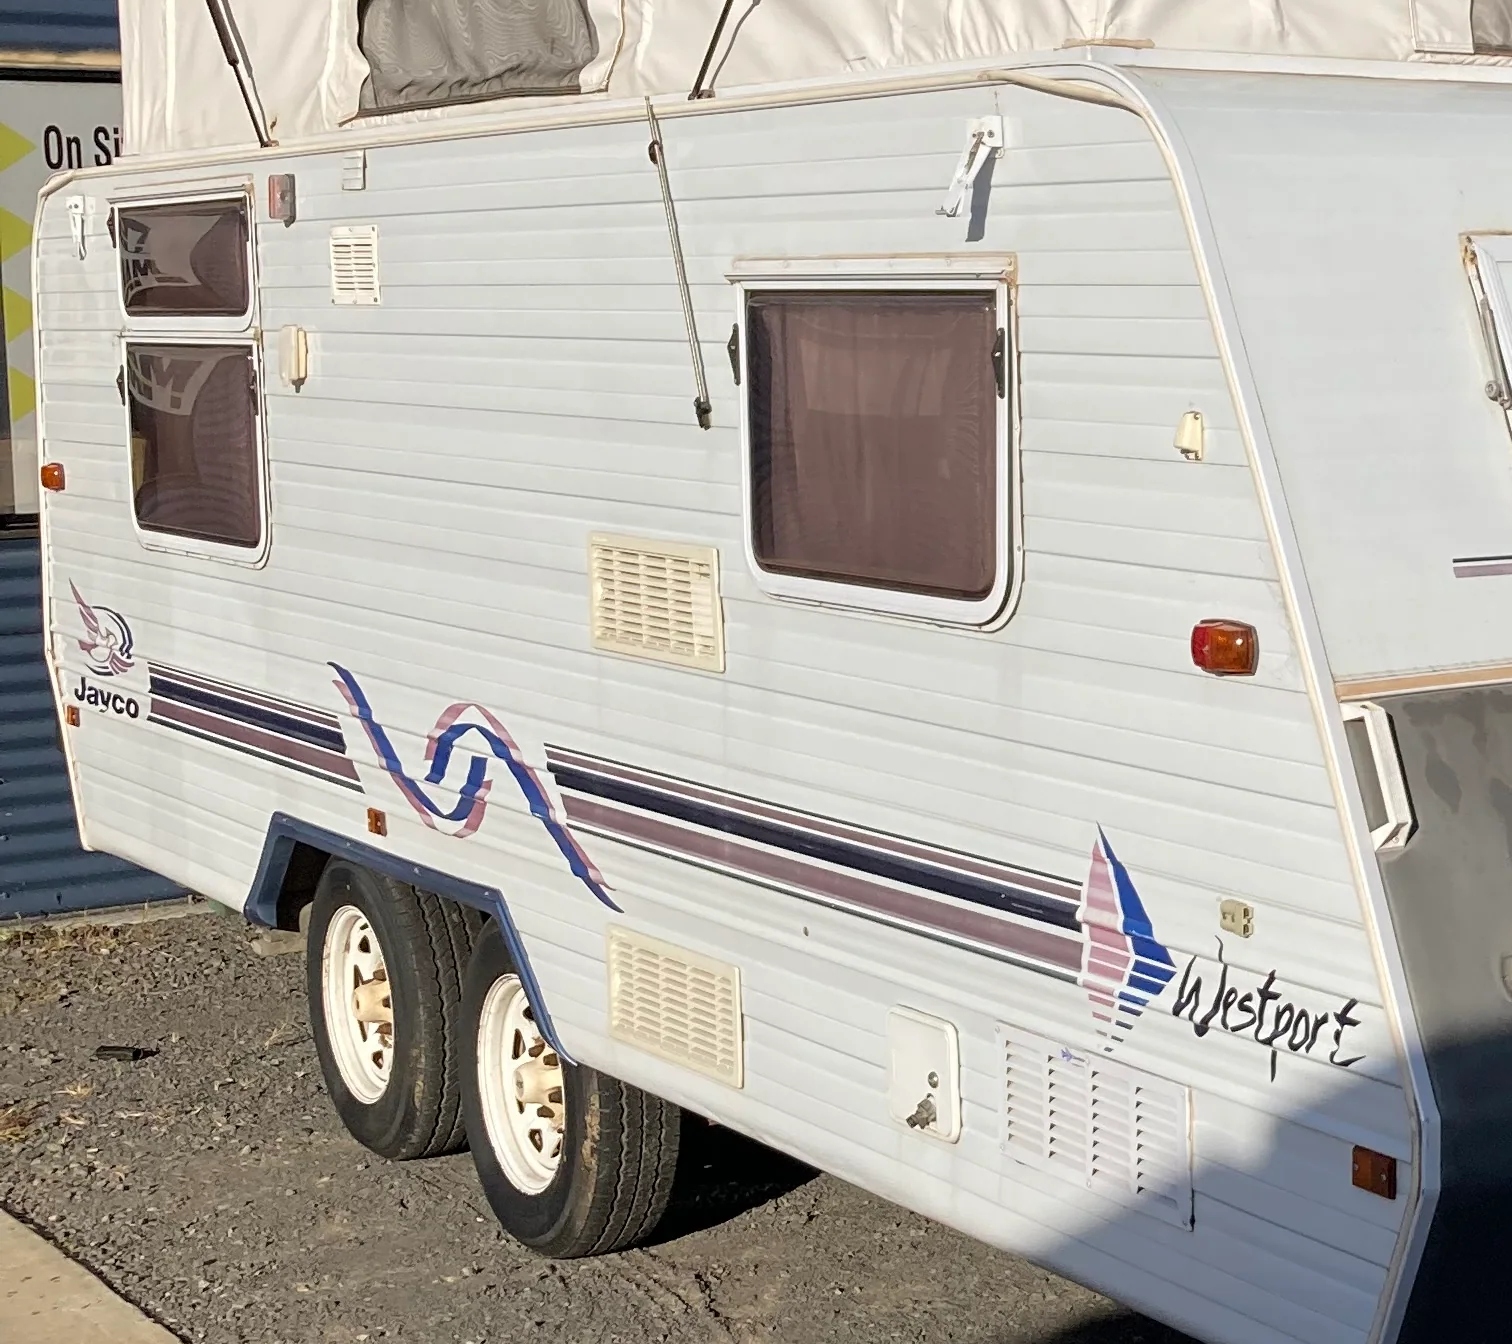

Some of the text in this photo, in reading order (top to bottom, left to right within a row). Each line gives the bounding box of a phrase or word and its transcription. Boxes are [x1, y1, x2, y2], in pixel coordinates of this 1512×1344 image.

[44, 125, 123, 169] On Si
[74, 676, 139, 718] Jayco
[1172, 935, 1366, 1082] Westport
